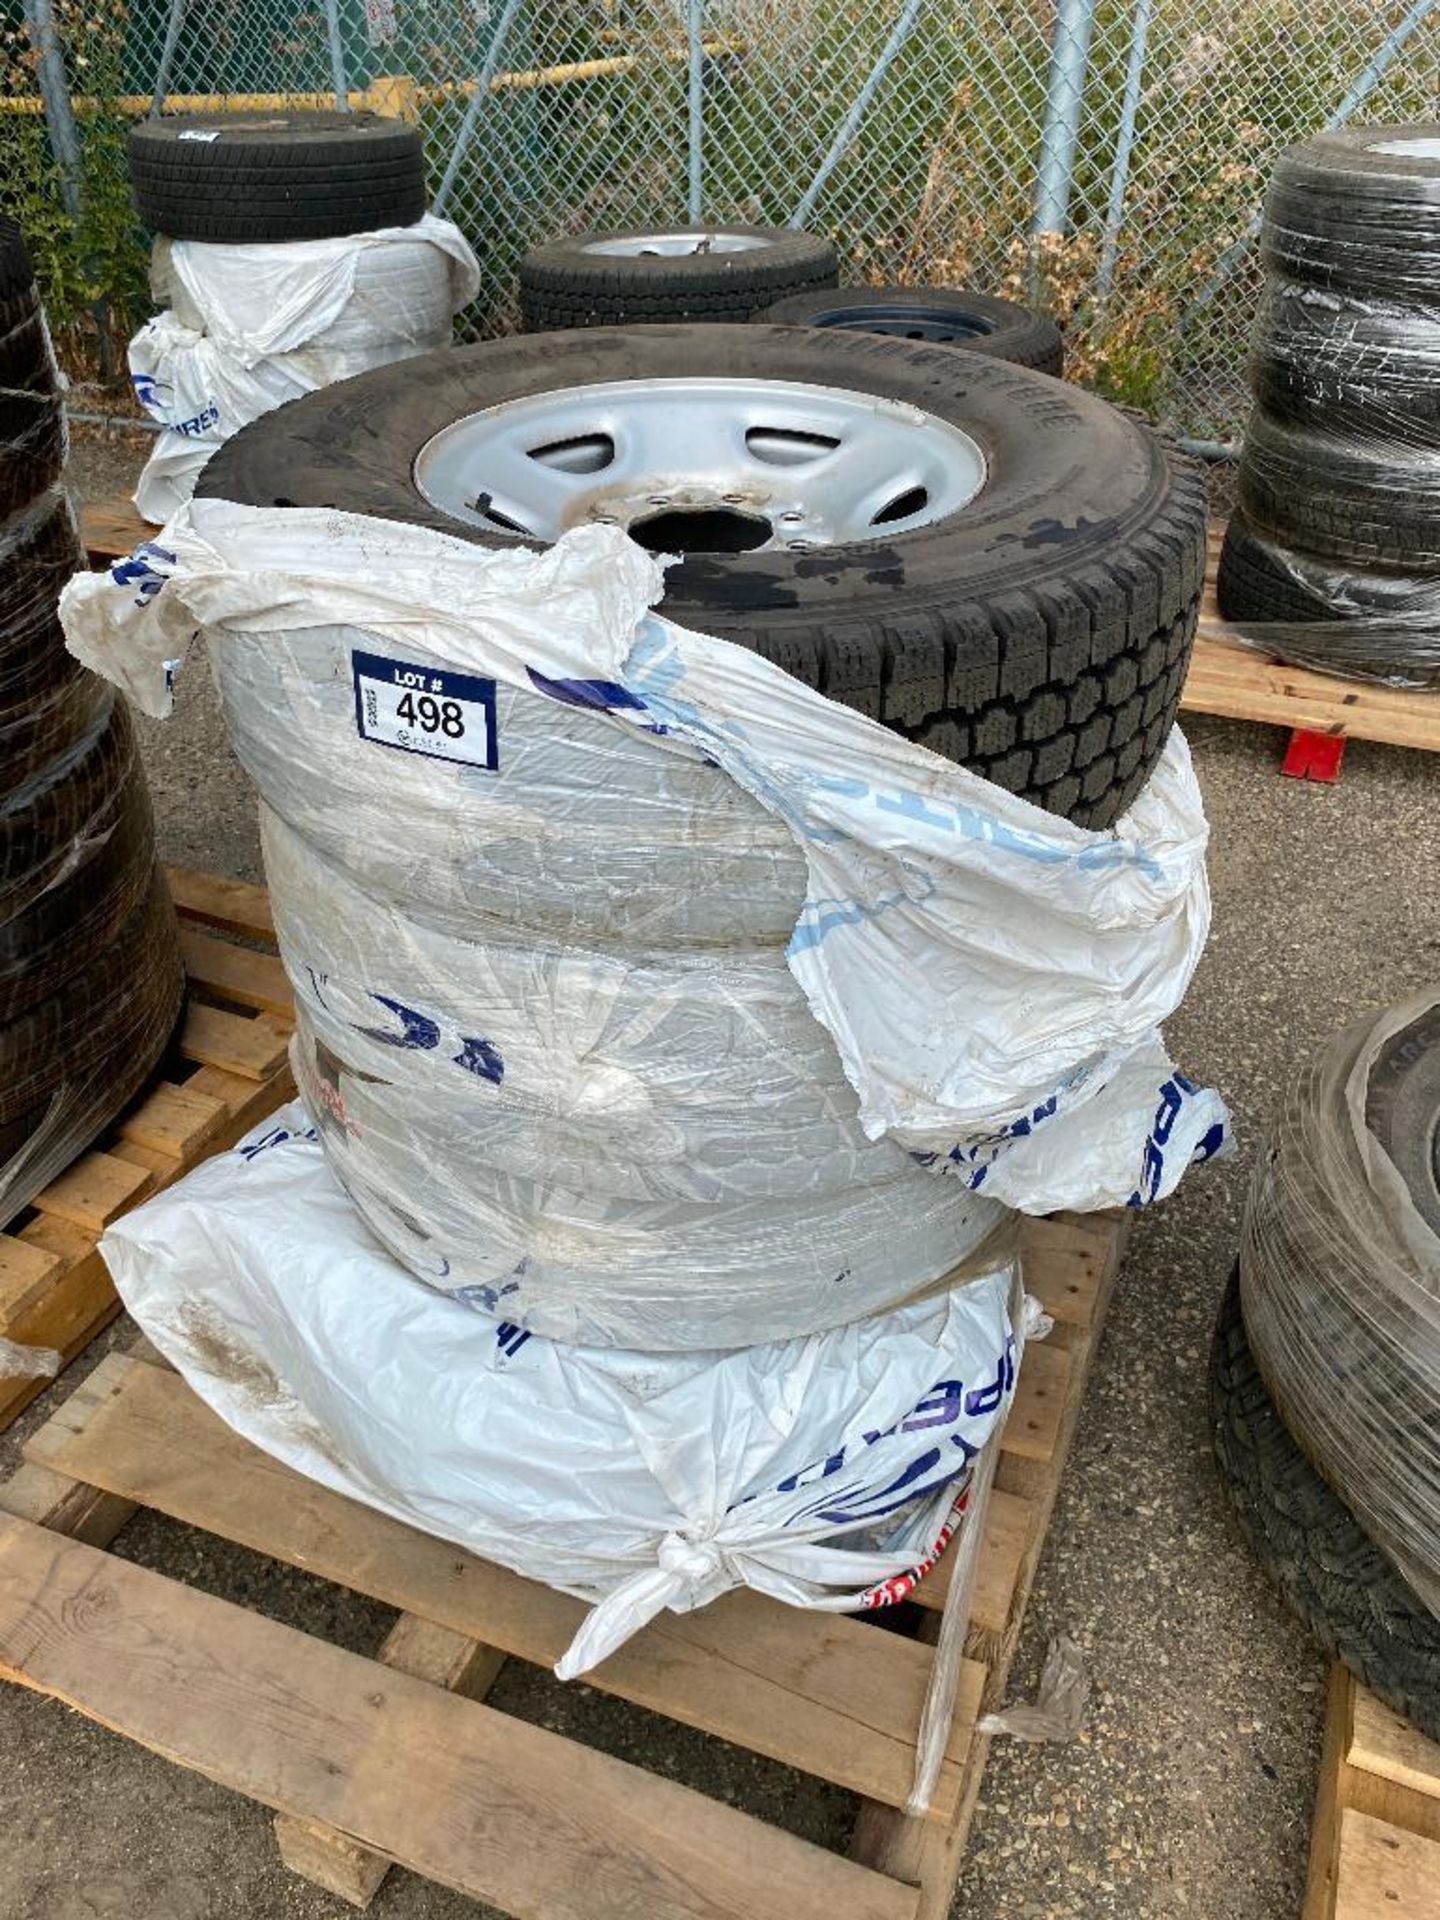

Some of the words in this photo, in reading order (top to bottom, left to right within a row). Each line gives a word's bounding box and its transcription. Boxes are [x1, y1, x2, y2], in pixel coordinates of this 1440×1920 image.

[169, 400, 219, 436] IRES
[394, 668, 426, 688] LOT
[430, 677, 443, 692] #
[396, 692, 465, 738] 498
